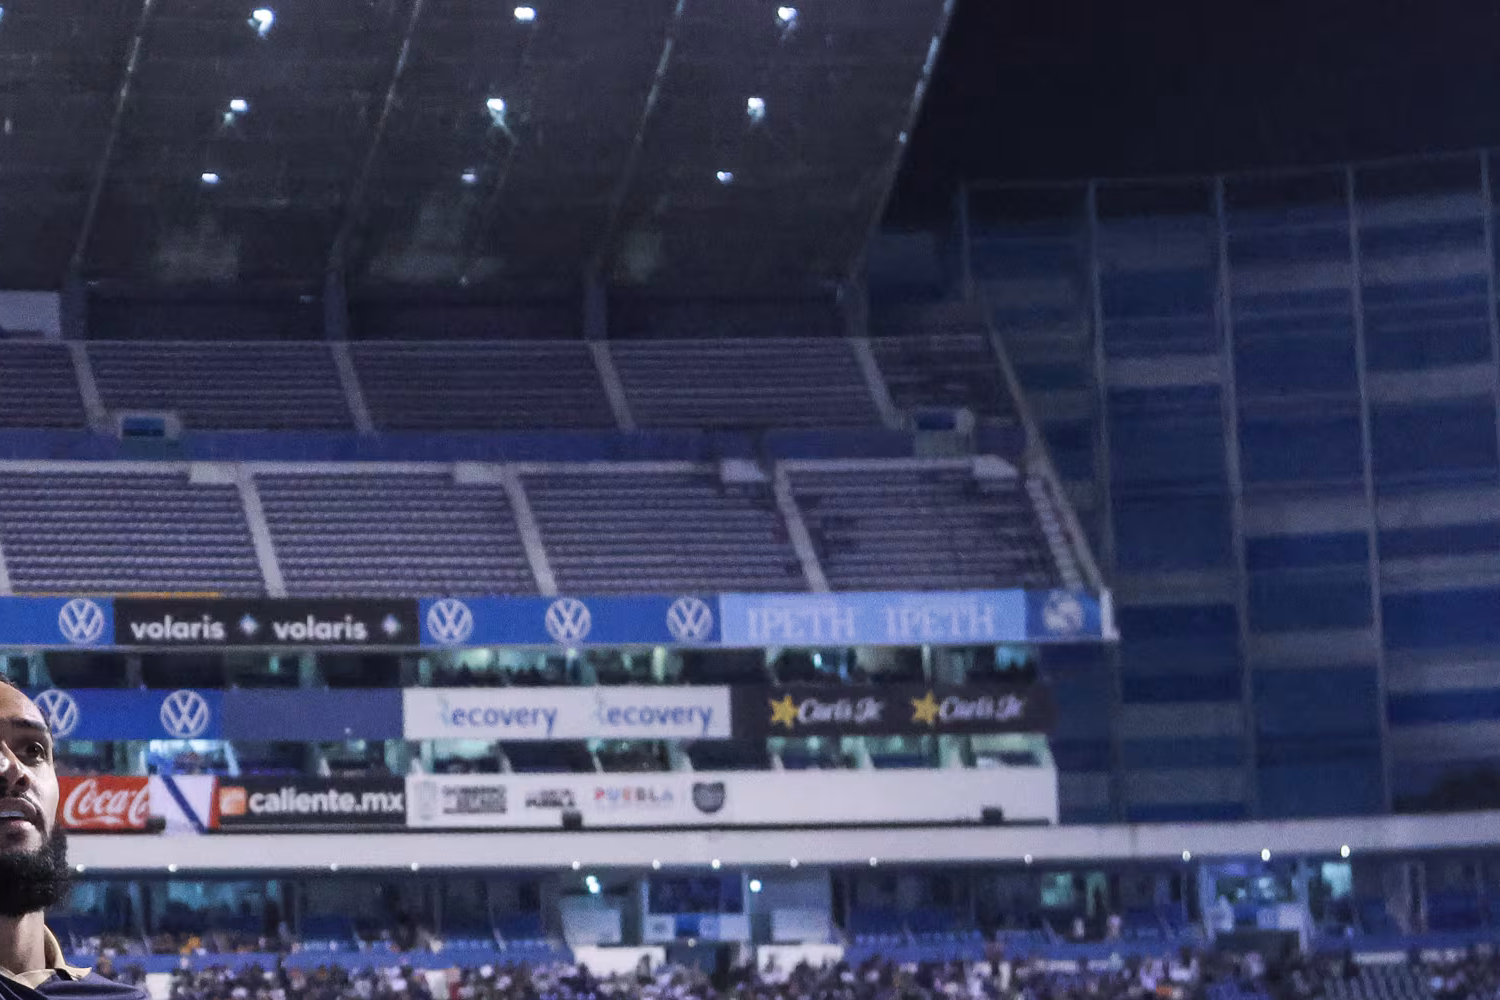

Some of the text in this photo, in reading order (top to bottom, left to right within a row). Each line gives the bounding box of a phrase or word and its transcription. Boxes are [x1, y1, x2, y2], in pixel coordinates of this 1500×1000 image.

[131, 614, 225, 640] volaris
[273, 614, 368, 640] volaris
[63, 779, 149, 826] Coca-C
[249, 787, 404, 814] caliente.mx
